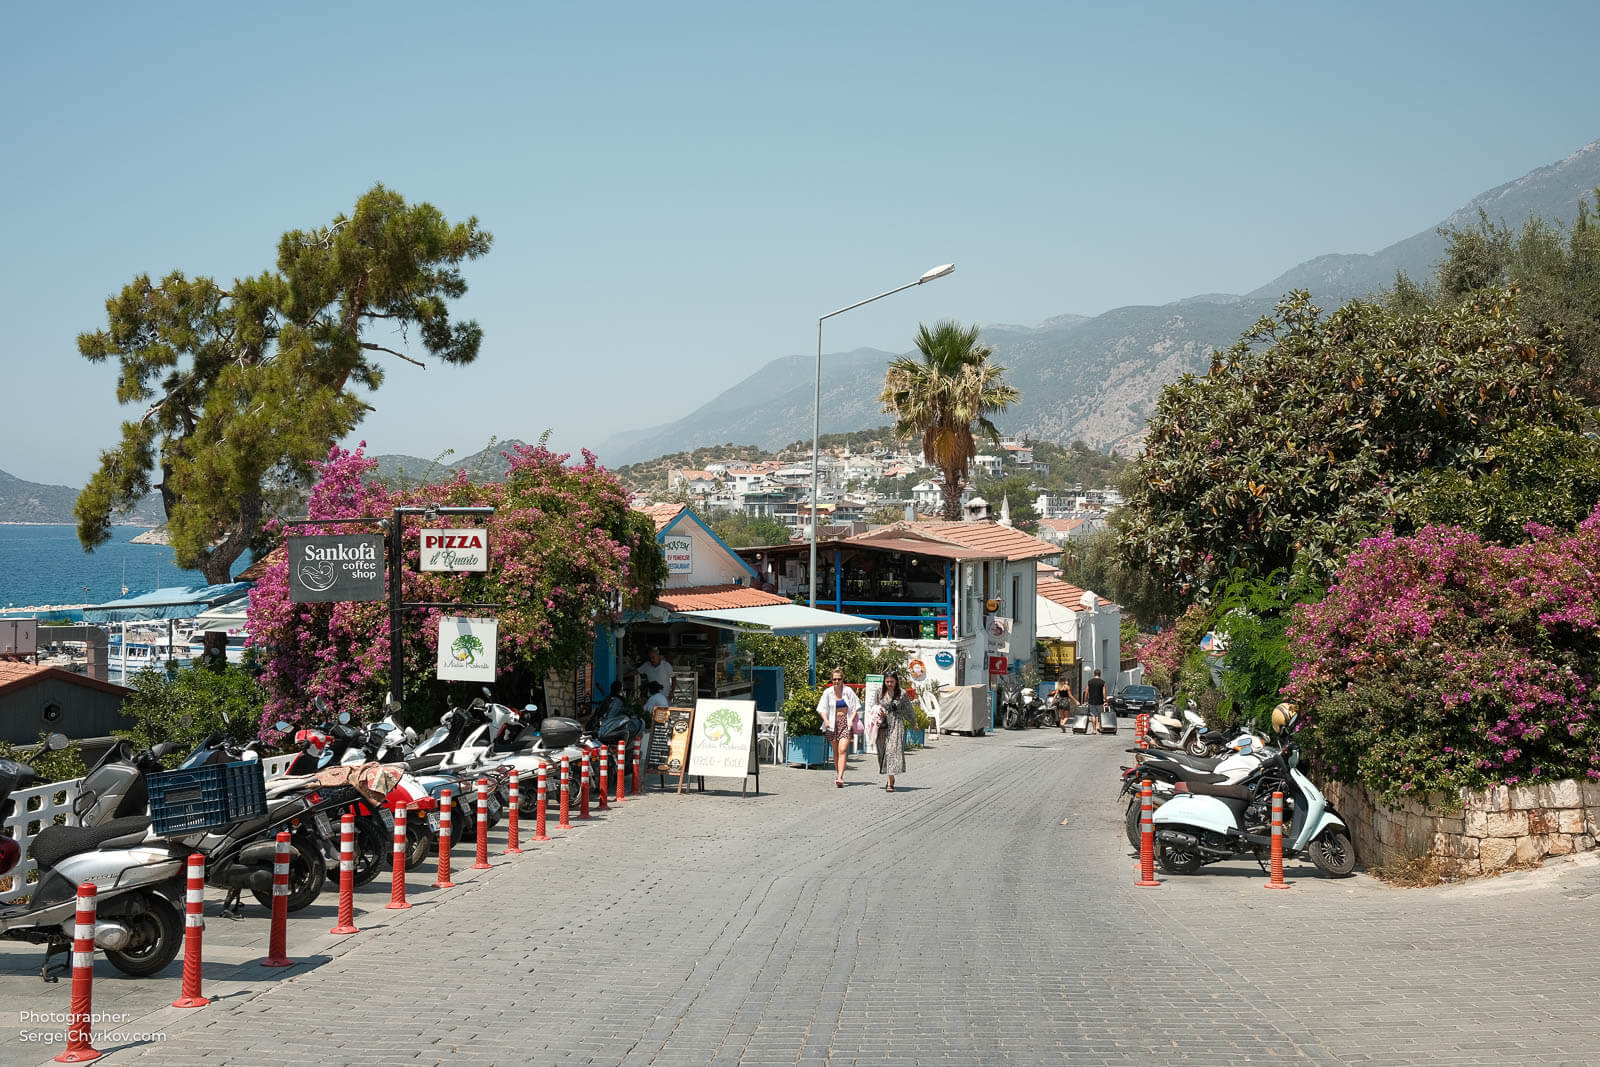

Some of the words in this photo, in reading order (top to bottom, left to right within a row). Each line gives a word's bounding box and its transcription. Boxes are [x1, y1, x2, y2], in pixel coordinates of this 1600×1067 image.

[425, 535, 482, 549] PIZZA
[304, 542, 375, 561] Sankofa
[342, 560, 376, 570] coffee
[351, 569, 376, 580] shop
